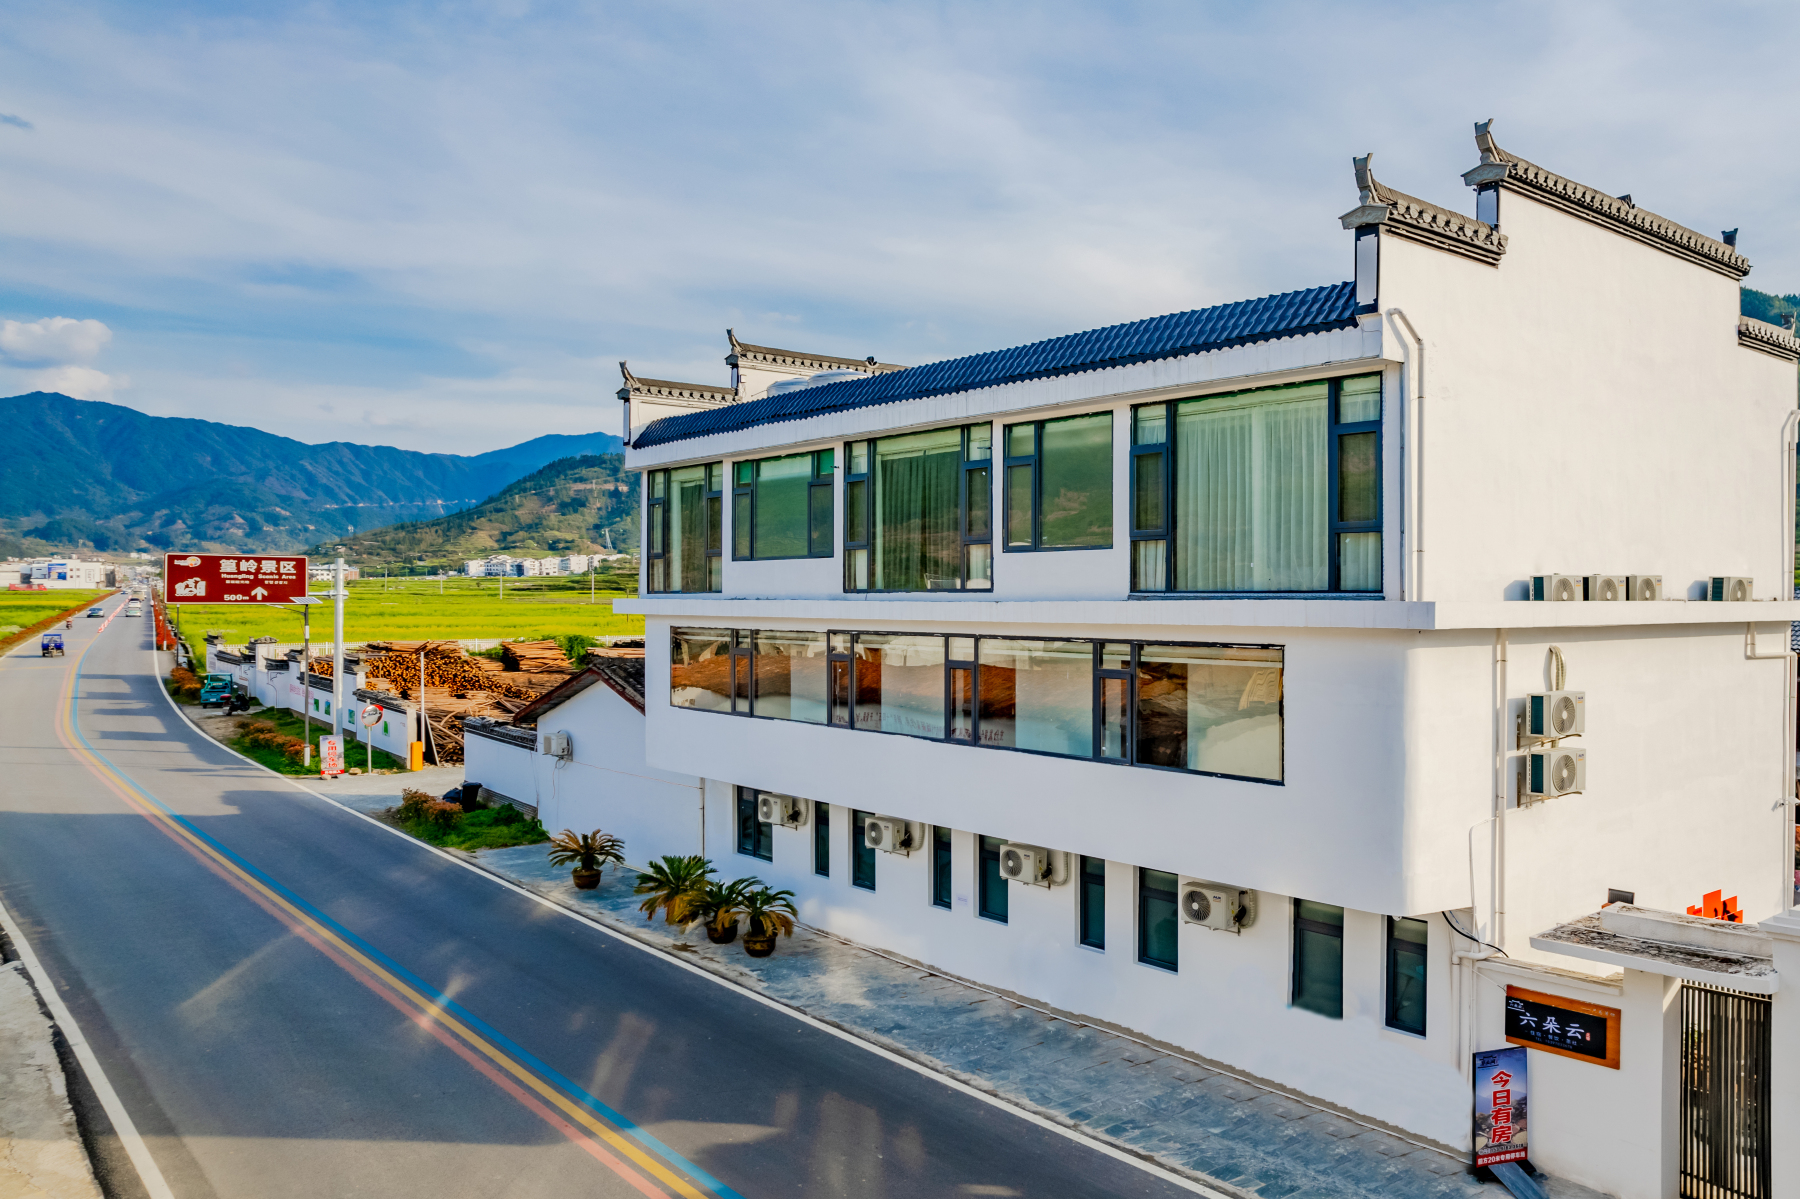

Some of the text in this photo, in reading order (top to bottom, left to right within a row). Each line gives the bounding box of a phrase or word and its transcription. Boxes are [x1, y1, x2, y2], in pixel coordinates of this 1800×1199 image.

[219, 559, 297, 574] 篁岭景区
[1519, 1011, 1585, 1039] 六朵云
[1491, 1070, 1513, 1144] 今日有房
